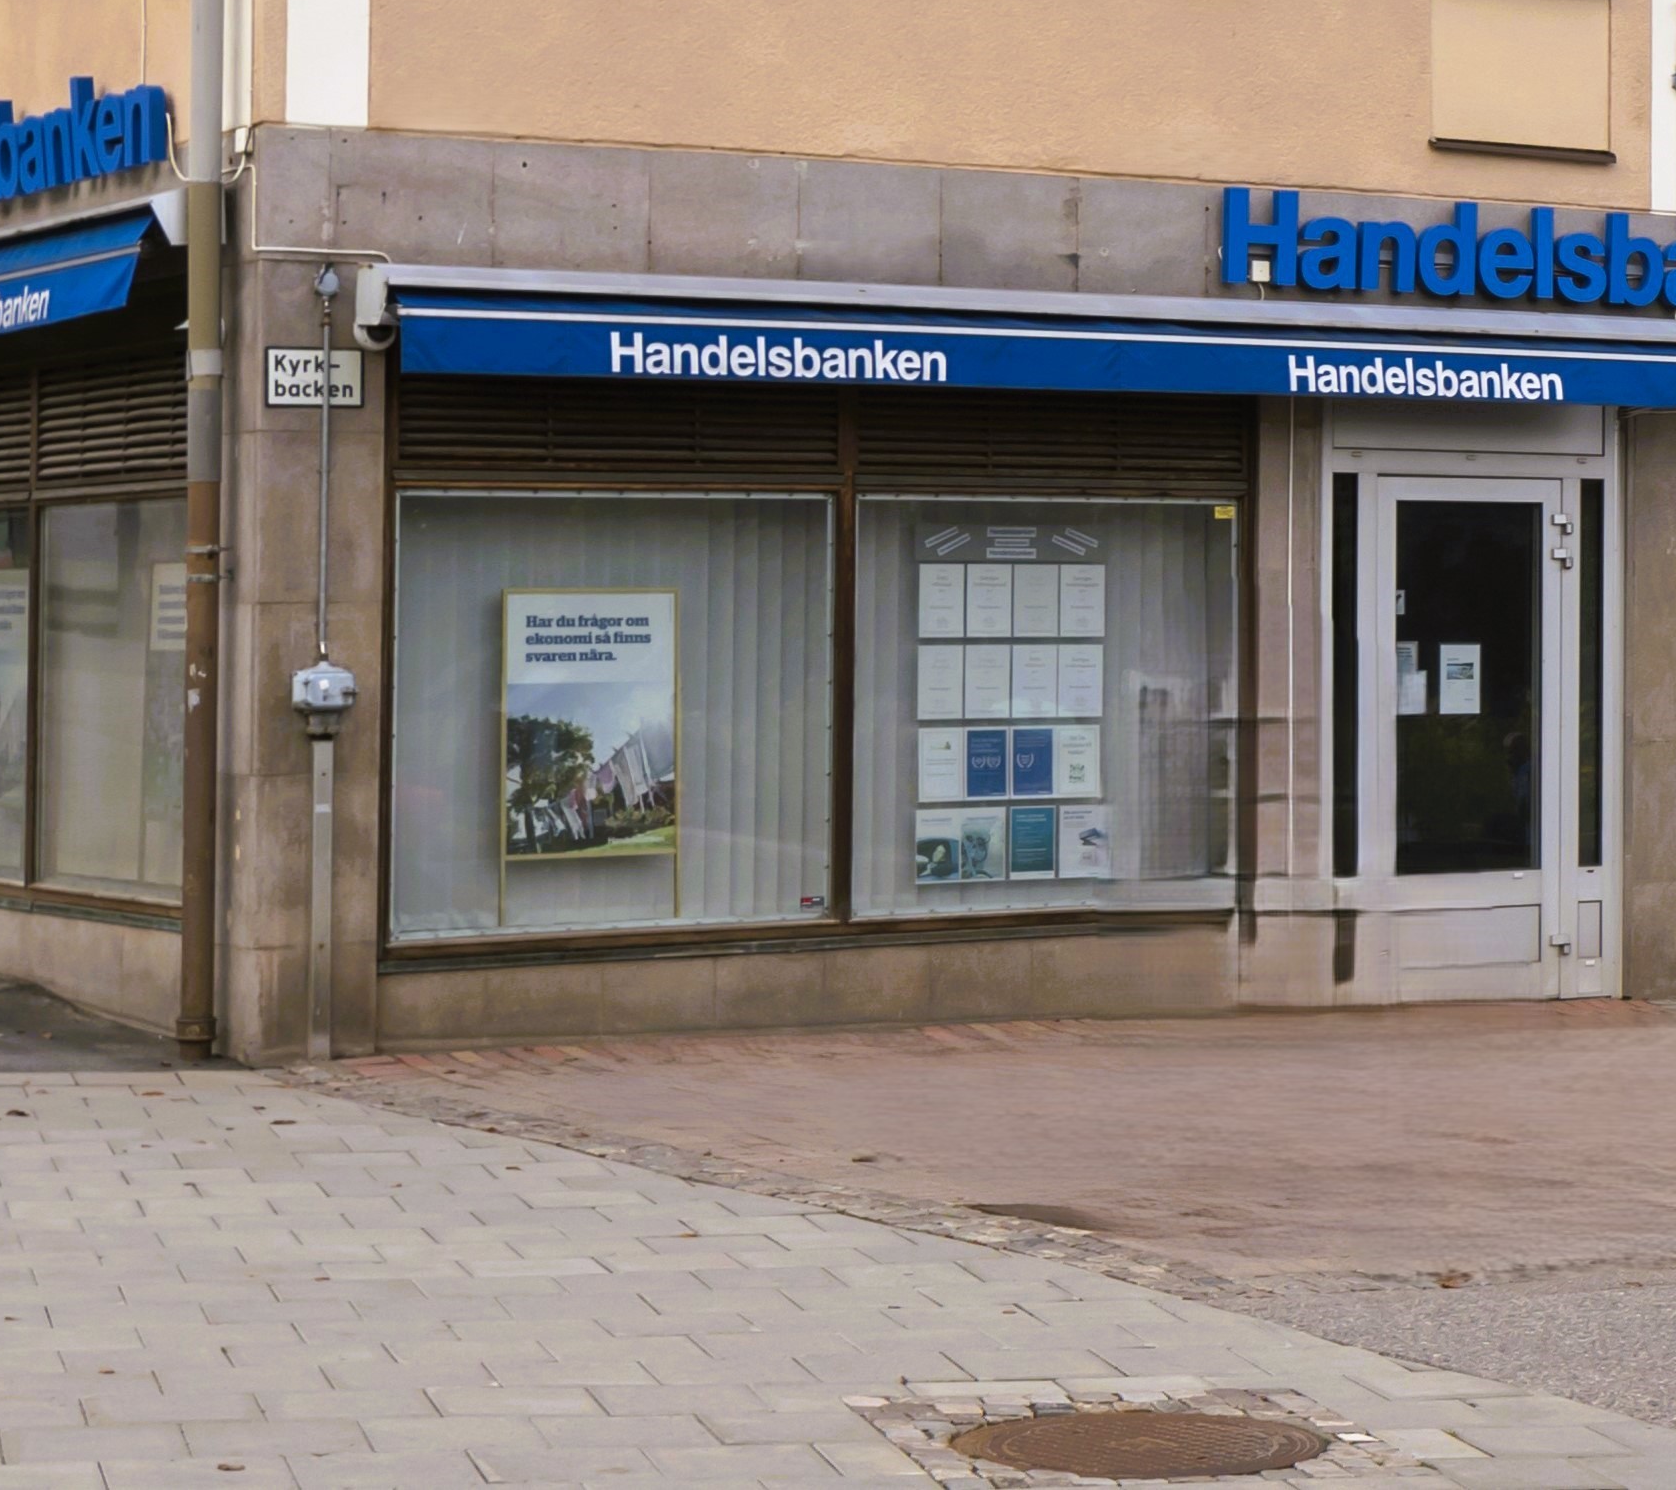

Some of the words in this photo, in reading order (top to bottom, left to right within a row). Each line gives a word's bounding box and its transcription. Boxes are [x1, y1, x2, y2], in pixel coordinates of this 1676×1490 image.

[274, 354, 340, 377] Kyrk-
[609, 330, 948, 382] Handelsbanken
[1287, 355, 1564, 402] Handelsbanken
[274, 379, 353, 398] backen
[525, 615, 554, 628] Har
[556, 615, 575, 628] du
[578, 613, 623, 630] frågor
[625, 616, 649, 627] om
[525, 632, 593, 645] ekonomi
[595, 631, 611, 644] så
[613, 631, 651, 644] finns
[525, 652, 577, 662] svaren
[579, 648, 617, 662] nära.
